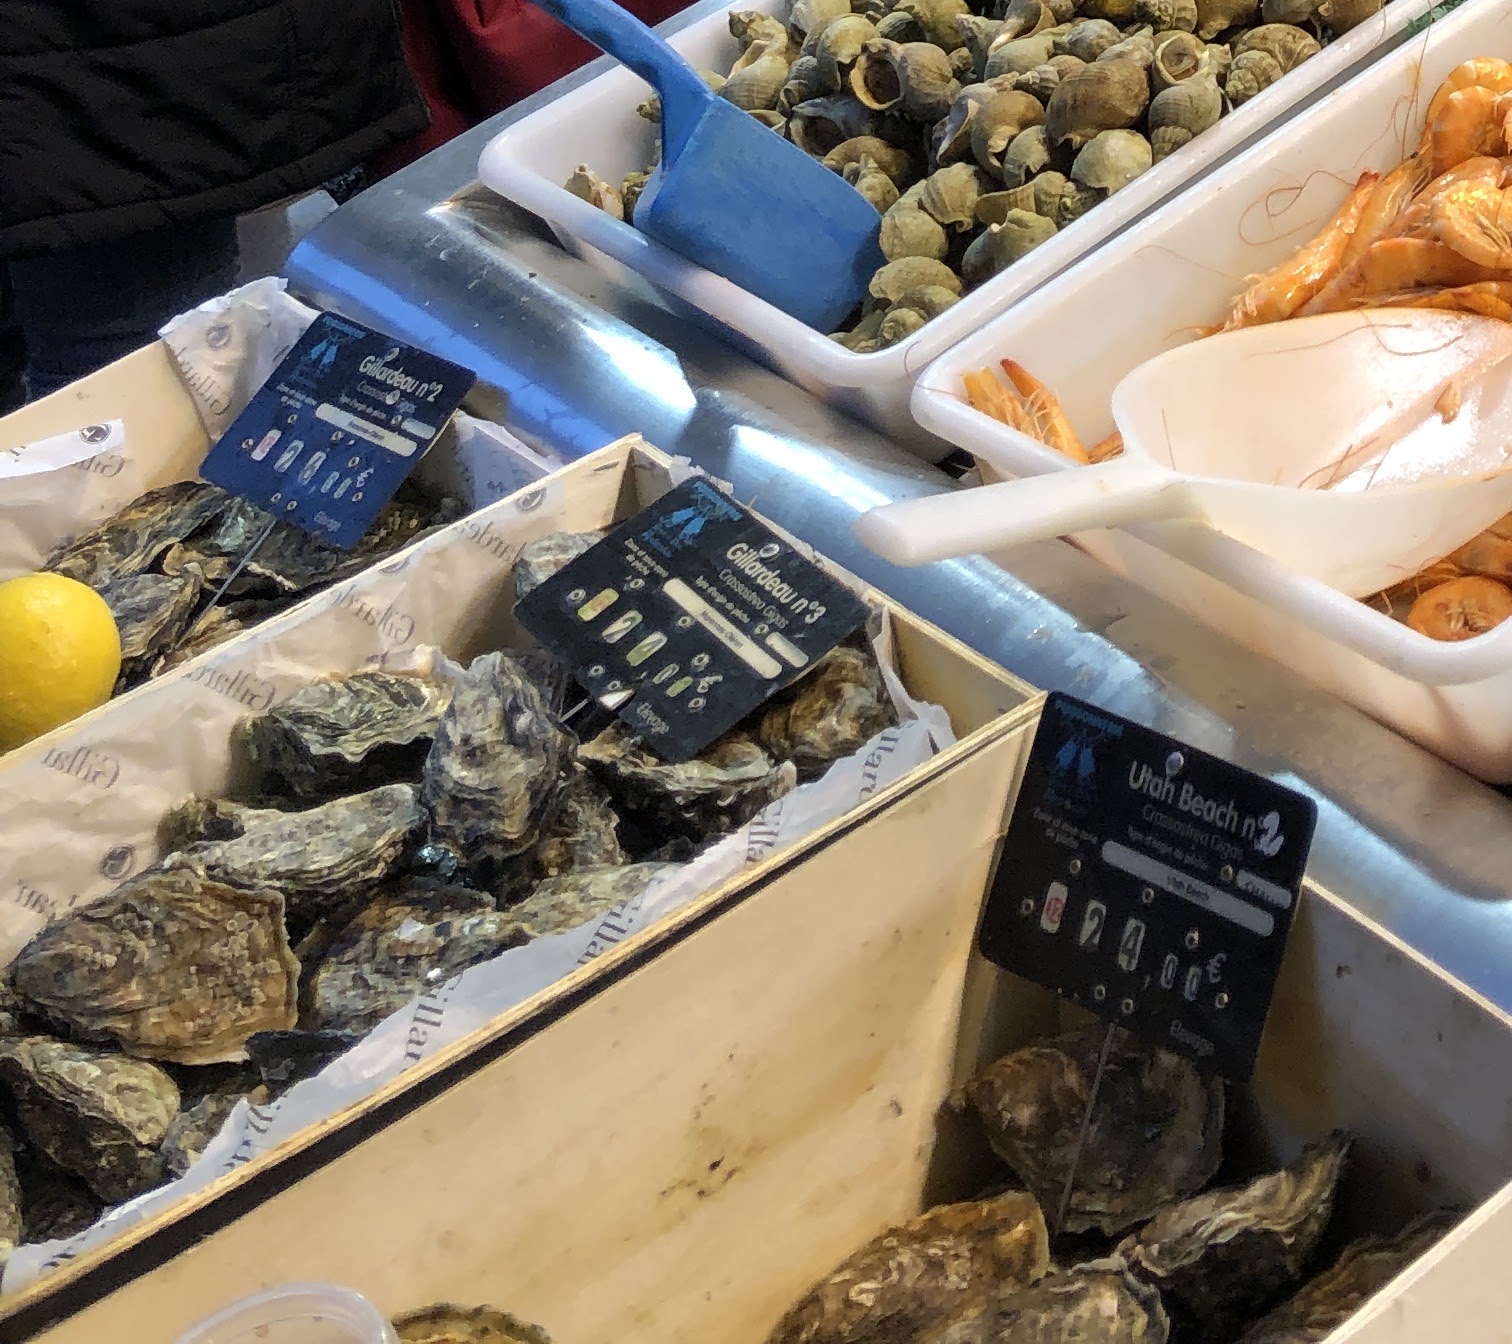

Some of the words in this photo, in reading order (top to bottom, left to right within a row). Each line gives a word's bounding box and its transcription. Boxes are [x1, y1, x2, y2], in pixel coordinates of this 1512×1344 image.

[358, 355, 422, 394] Gillardeau
[726, 542, 797, 605] Gillardeau
[792, 597, 828, 625] n°3
[1128, 759, 1175, 806] Utah
[1178, 782, 1240, 834] Beach
